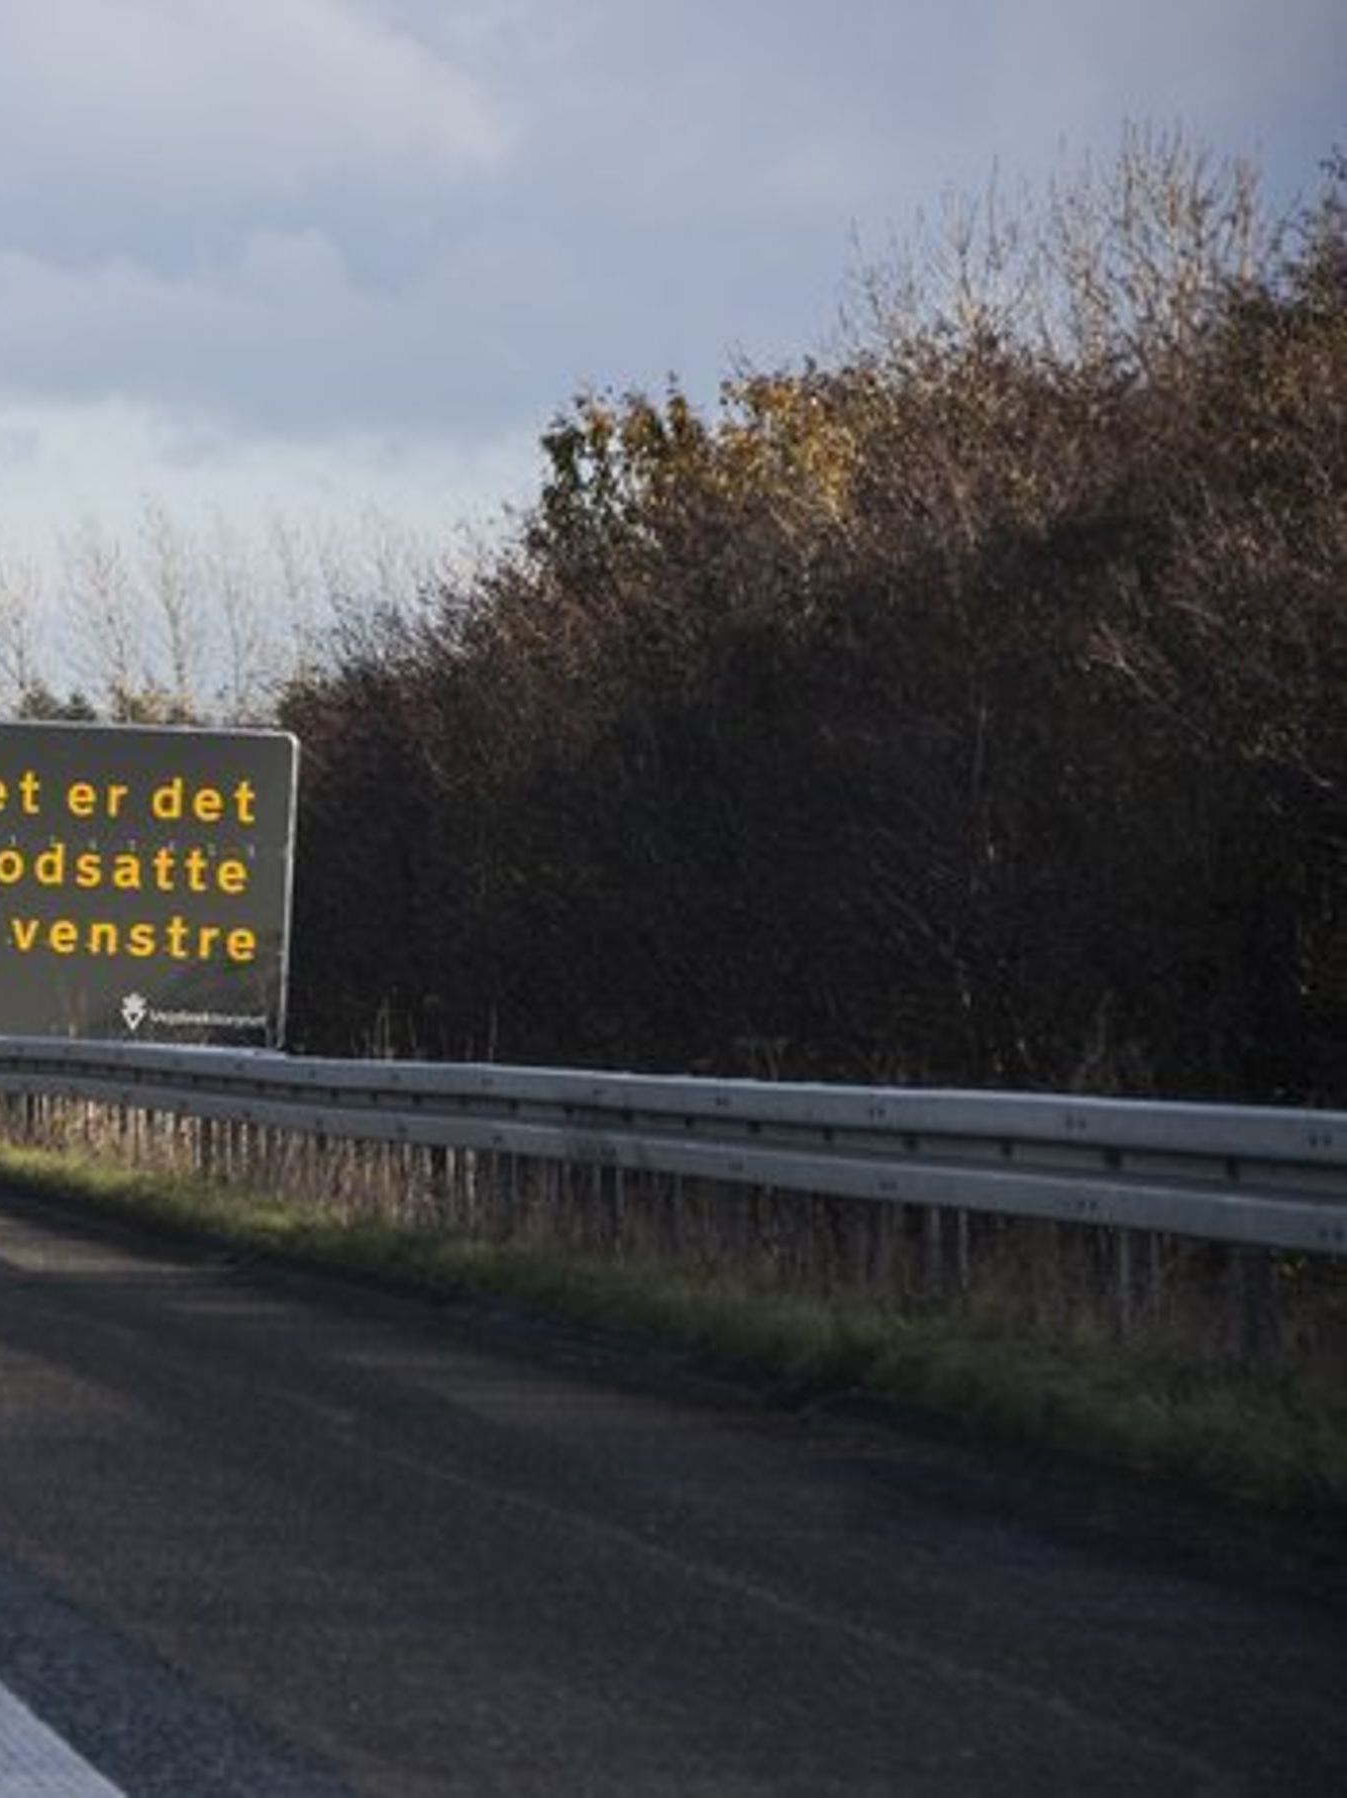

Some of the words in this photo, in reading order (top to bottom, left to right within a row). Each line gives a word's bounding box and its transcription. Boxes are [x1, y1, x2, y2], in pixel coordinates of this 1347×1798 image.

[67, 781, 128, 817] er
[150, 777, 256, 824] det
[11, 914, 257, 962] venstre
